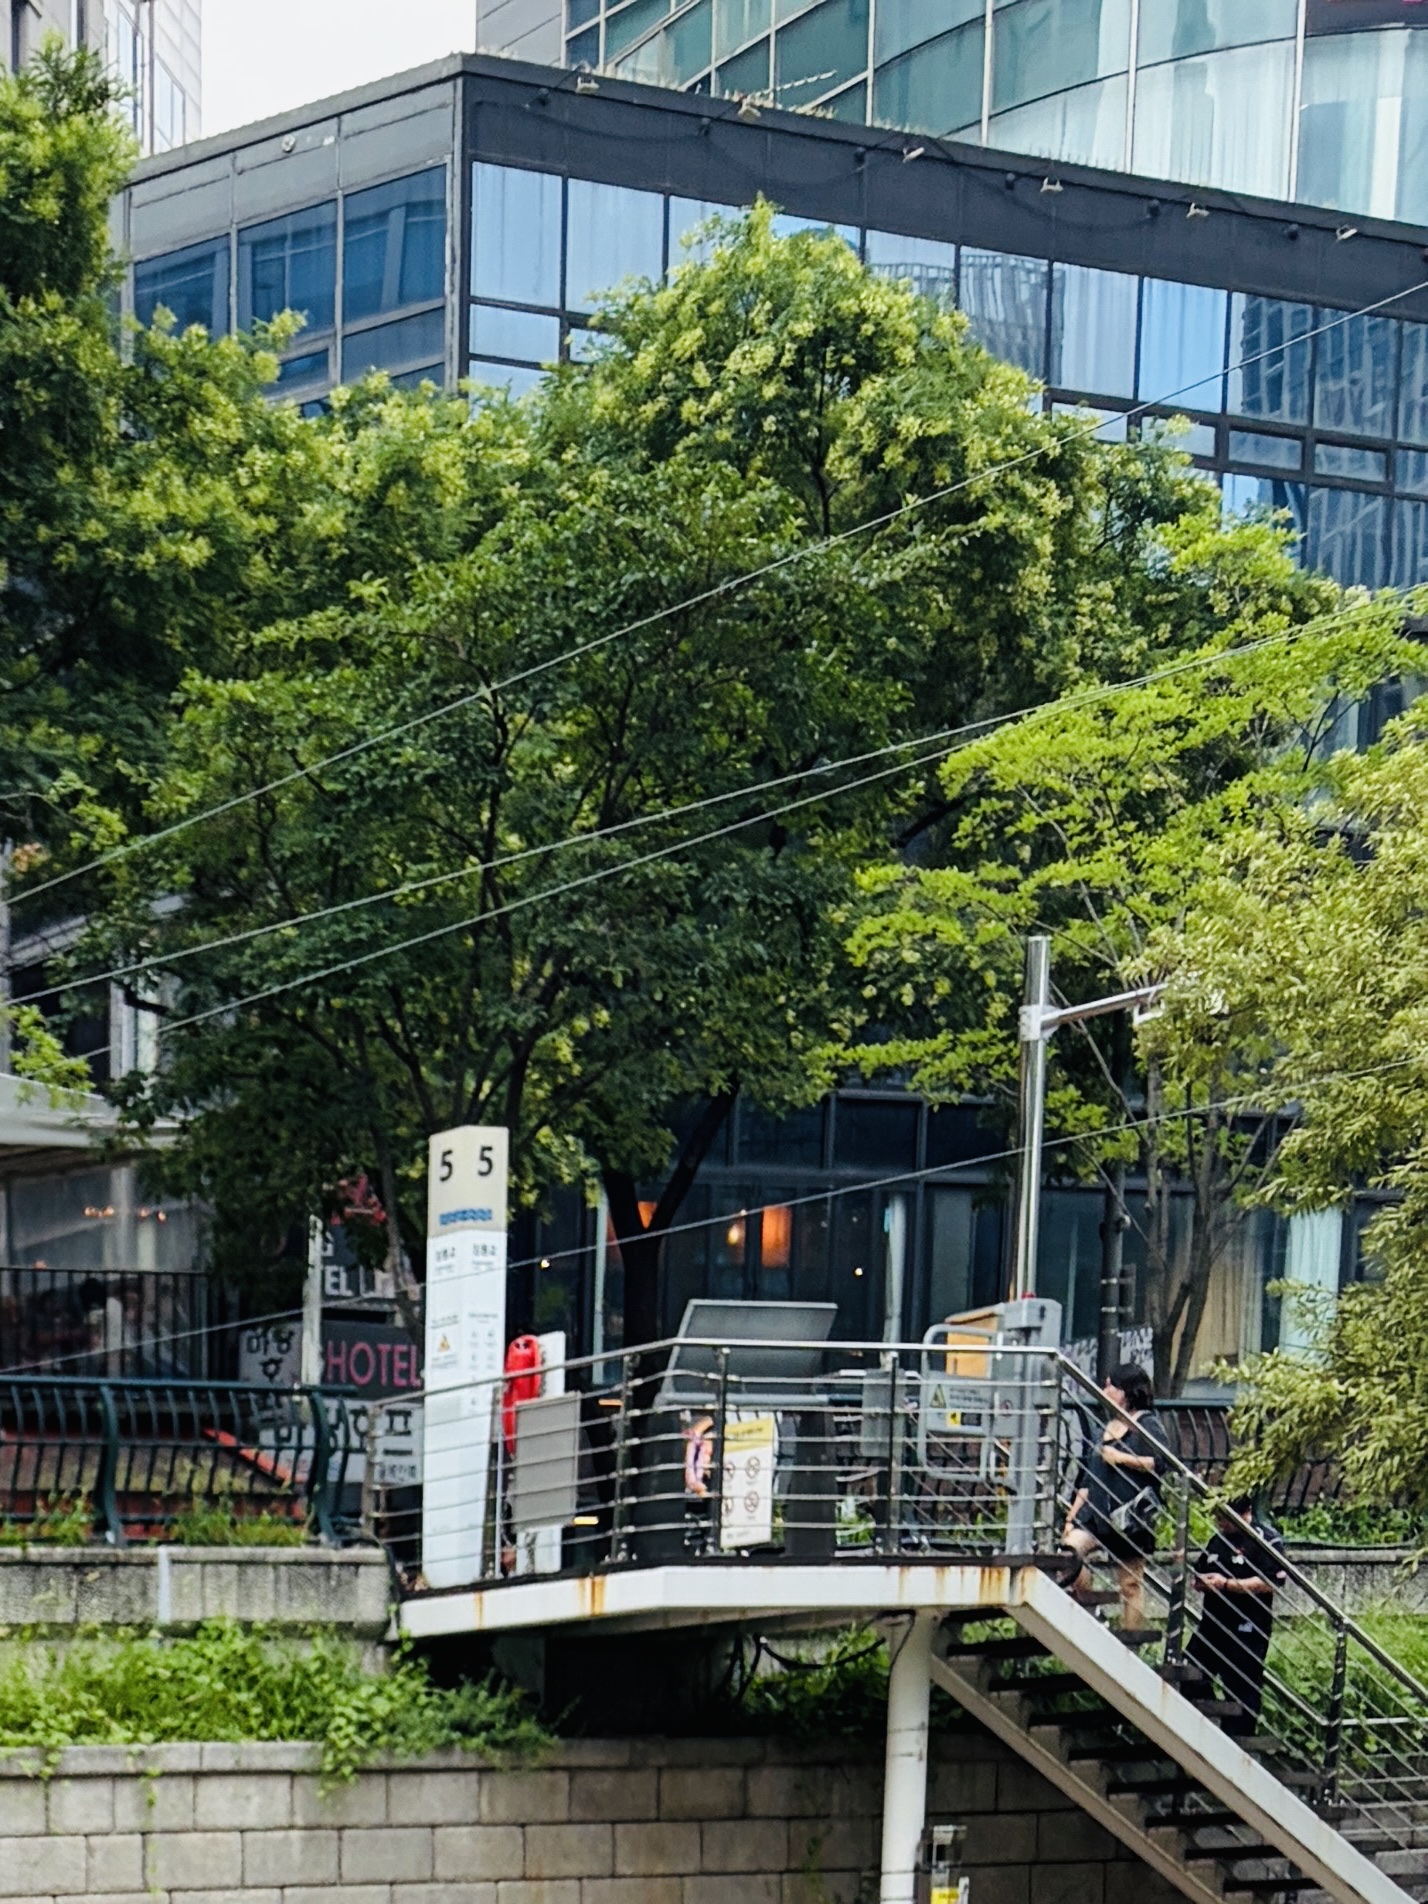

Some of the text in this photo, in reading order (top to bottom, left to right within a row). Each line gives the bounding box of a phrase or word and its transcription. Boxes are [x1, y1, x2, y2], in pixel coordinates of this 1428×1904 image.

[439, 1149, 453, 1182] 5
[477, 1145, 493, 1177] 5
[325, 1340, 422, 1388] HOTEL
